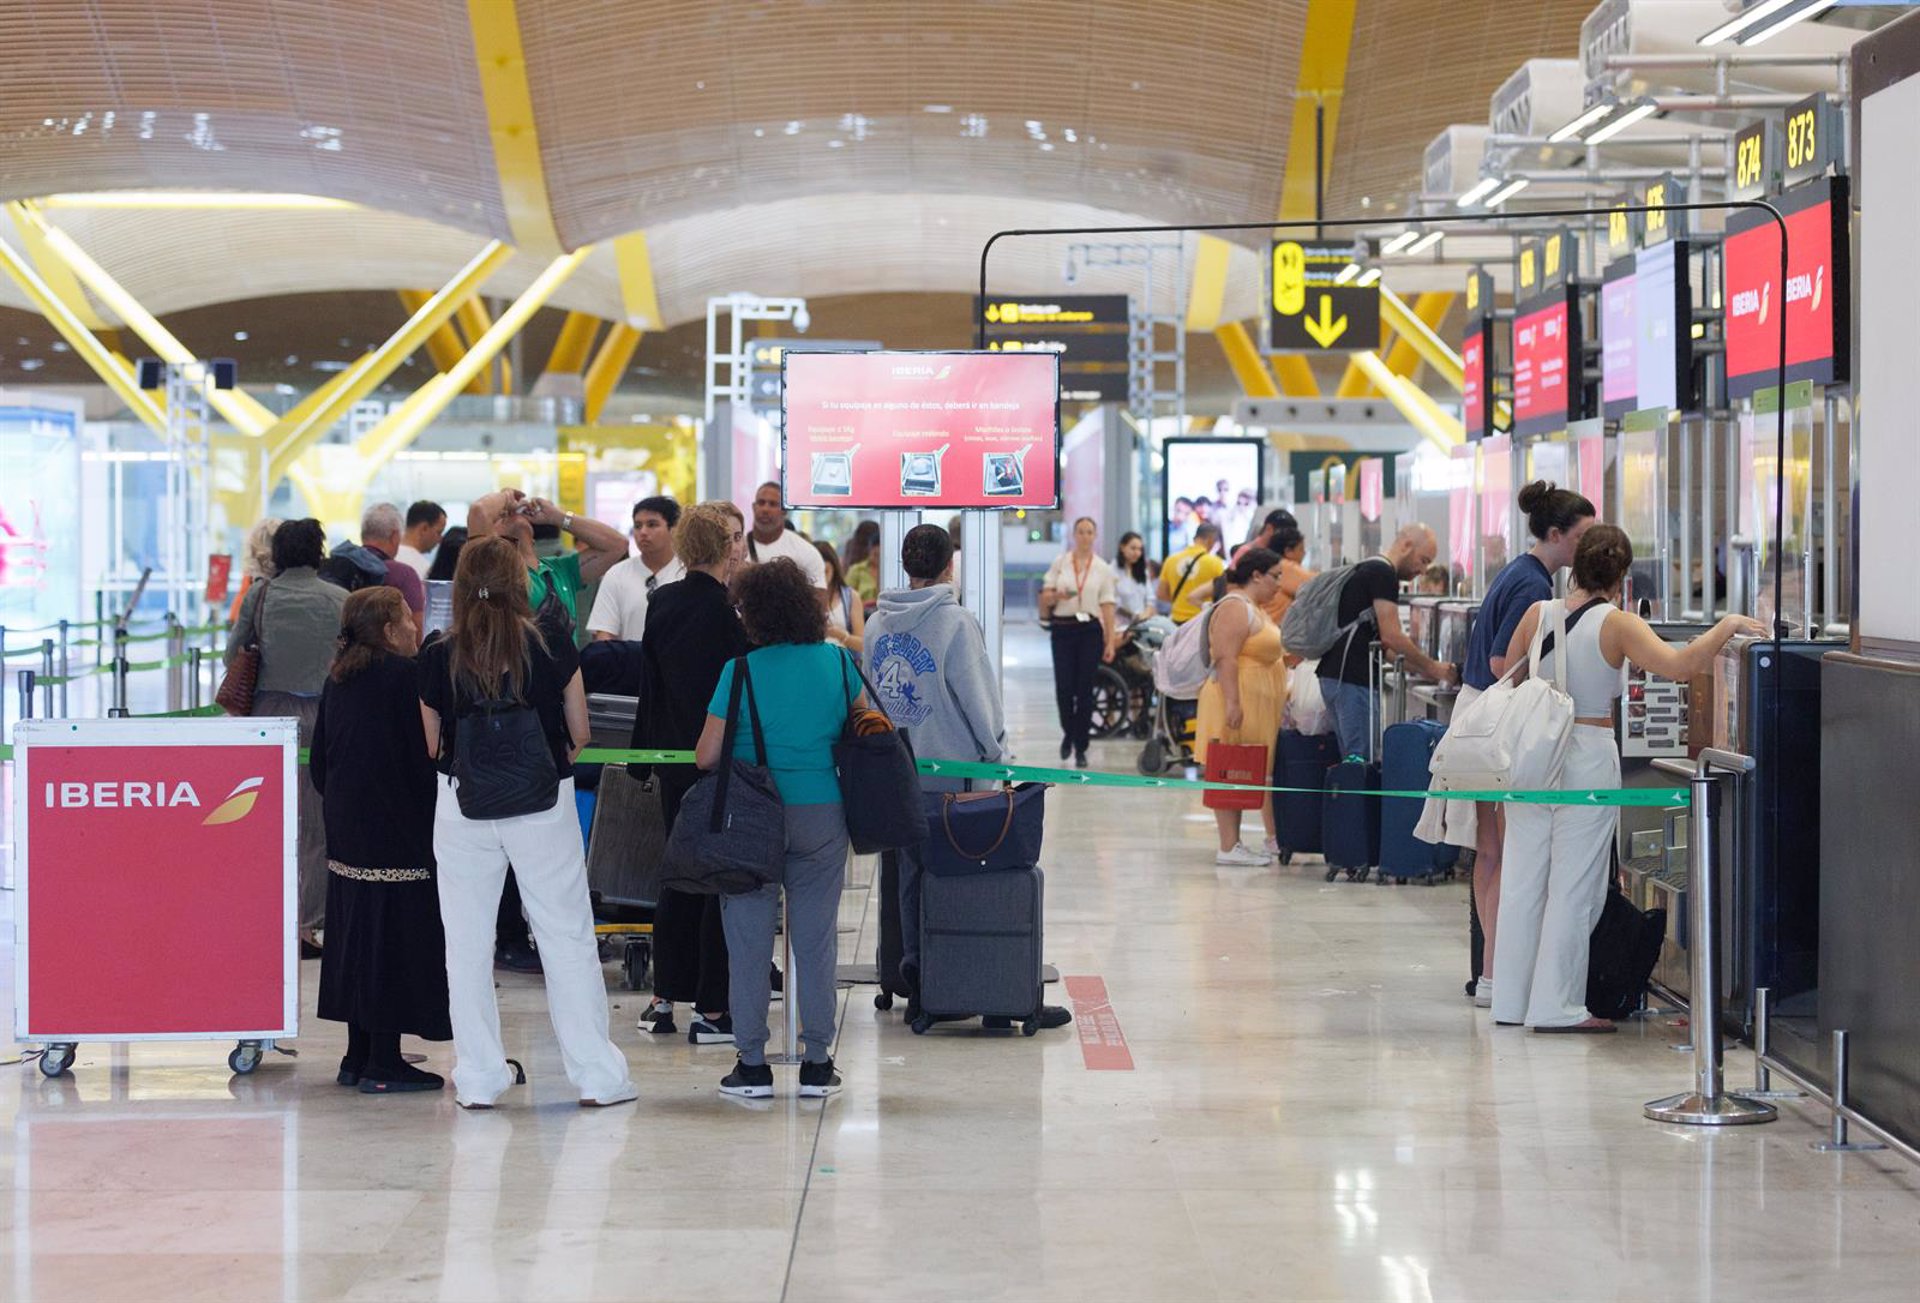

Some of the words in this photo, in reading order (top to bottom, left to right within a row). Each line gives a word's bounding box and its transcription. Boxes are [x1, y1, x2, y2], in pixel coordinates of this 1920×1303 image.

[1788, 110, 1815, 169] 873
[1737, 134, 1762, 189] 874
[1732, 289, 1760, 317] IBERIA
[1786, 273, 1812, 303] BERIA
[892, 366, 935, 376] IBERIA
[882, 661, 902, 699] 4
[45, 781, 201, 808] IBERIA
